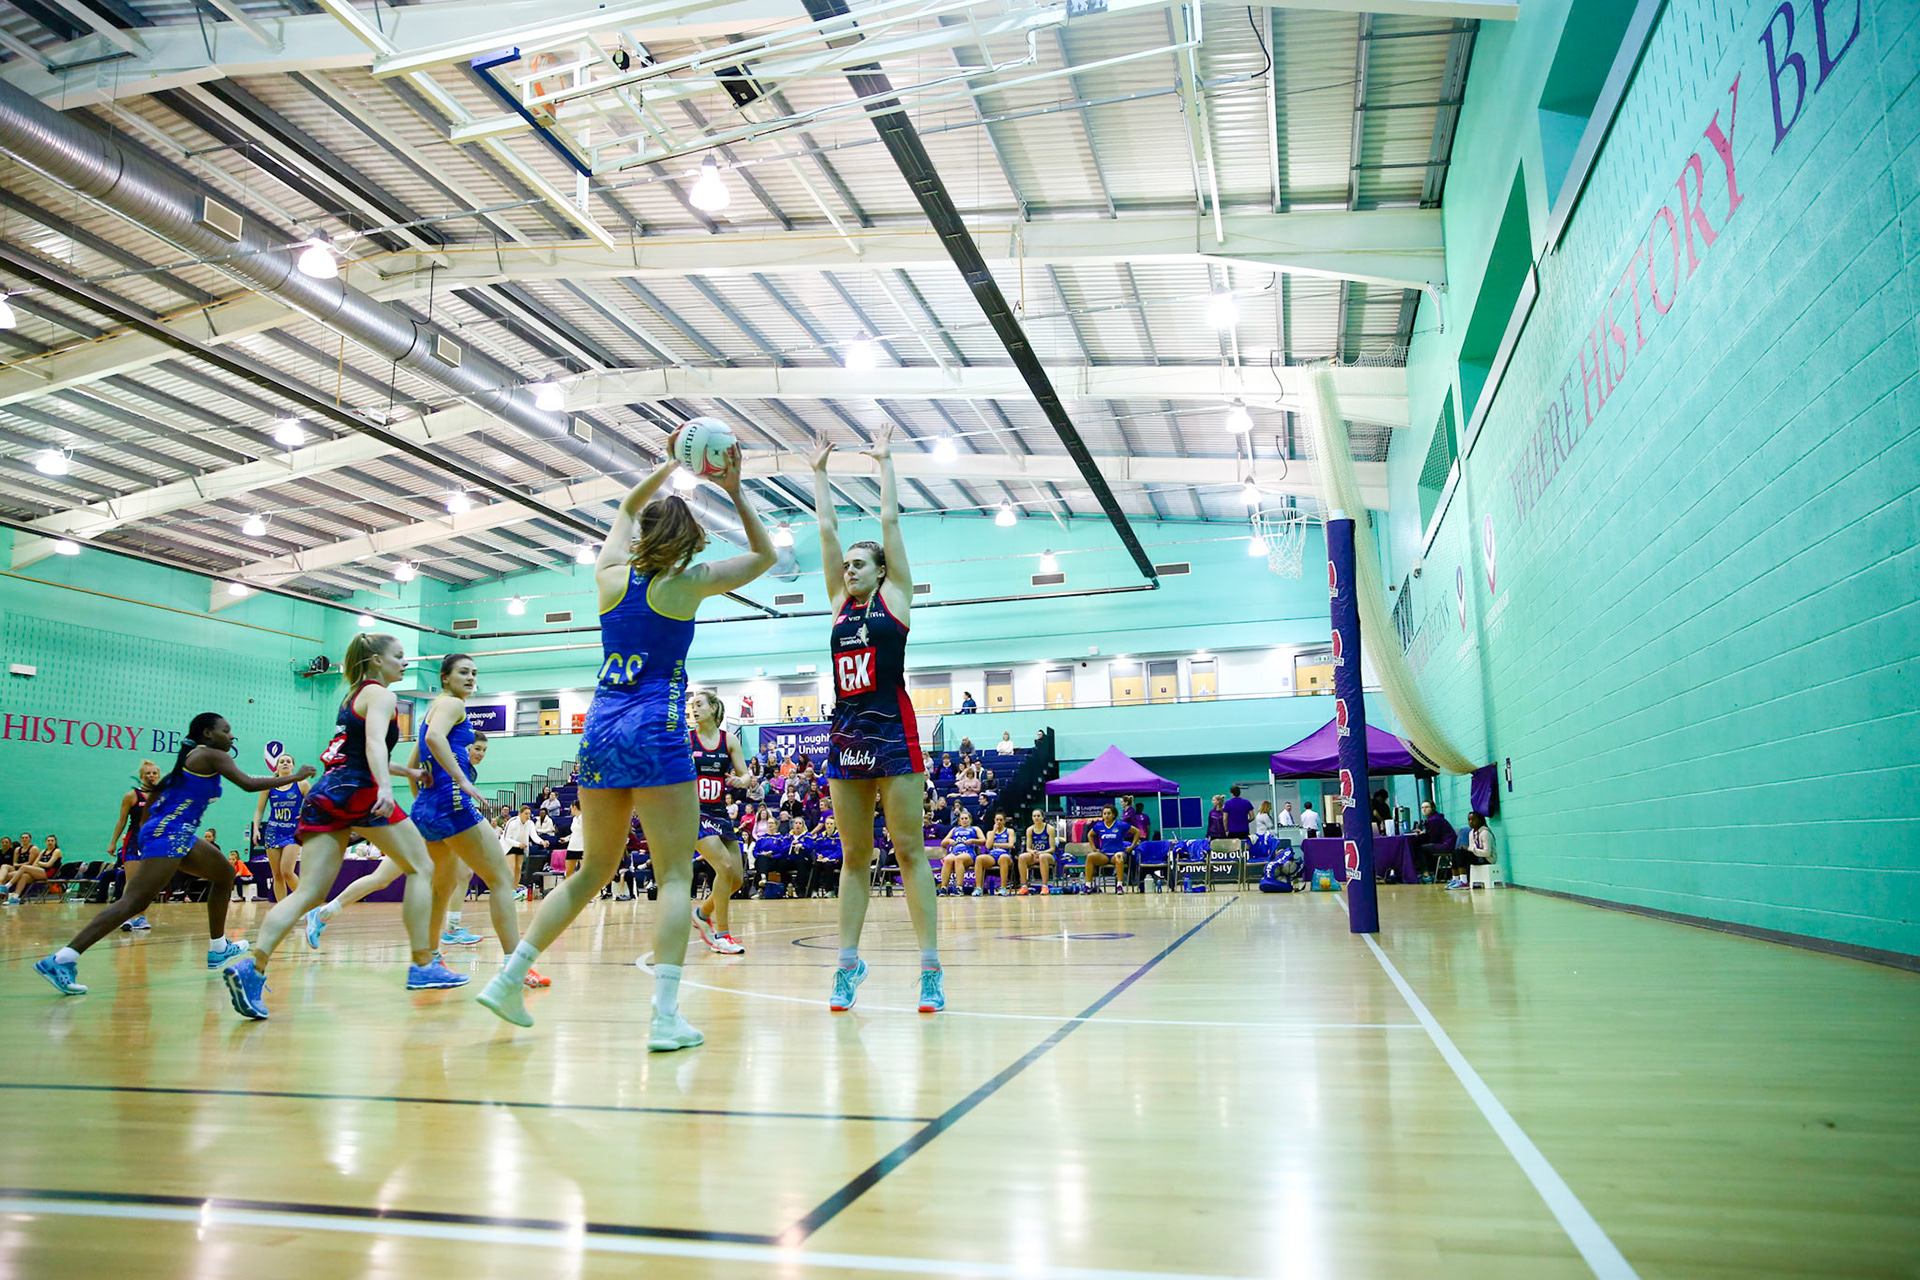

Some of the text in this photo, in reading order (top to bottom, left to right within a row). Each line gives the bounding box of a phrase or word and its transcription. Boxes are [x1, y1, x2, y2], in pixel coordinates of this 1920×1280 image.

[1508, 373, 1579, 526] WHERE
[1579, 71, 1745, 428] HISTORY
[838, 652, 871, 692] GK
[2, 713, 144, 751] HISTORY
[840, 747, 876, 771] Vitality
[699, 778, 721, 801] GD
[275, 808, 292, 821] WD
[1177, 863, 1233, 875] Univesity
